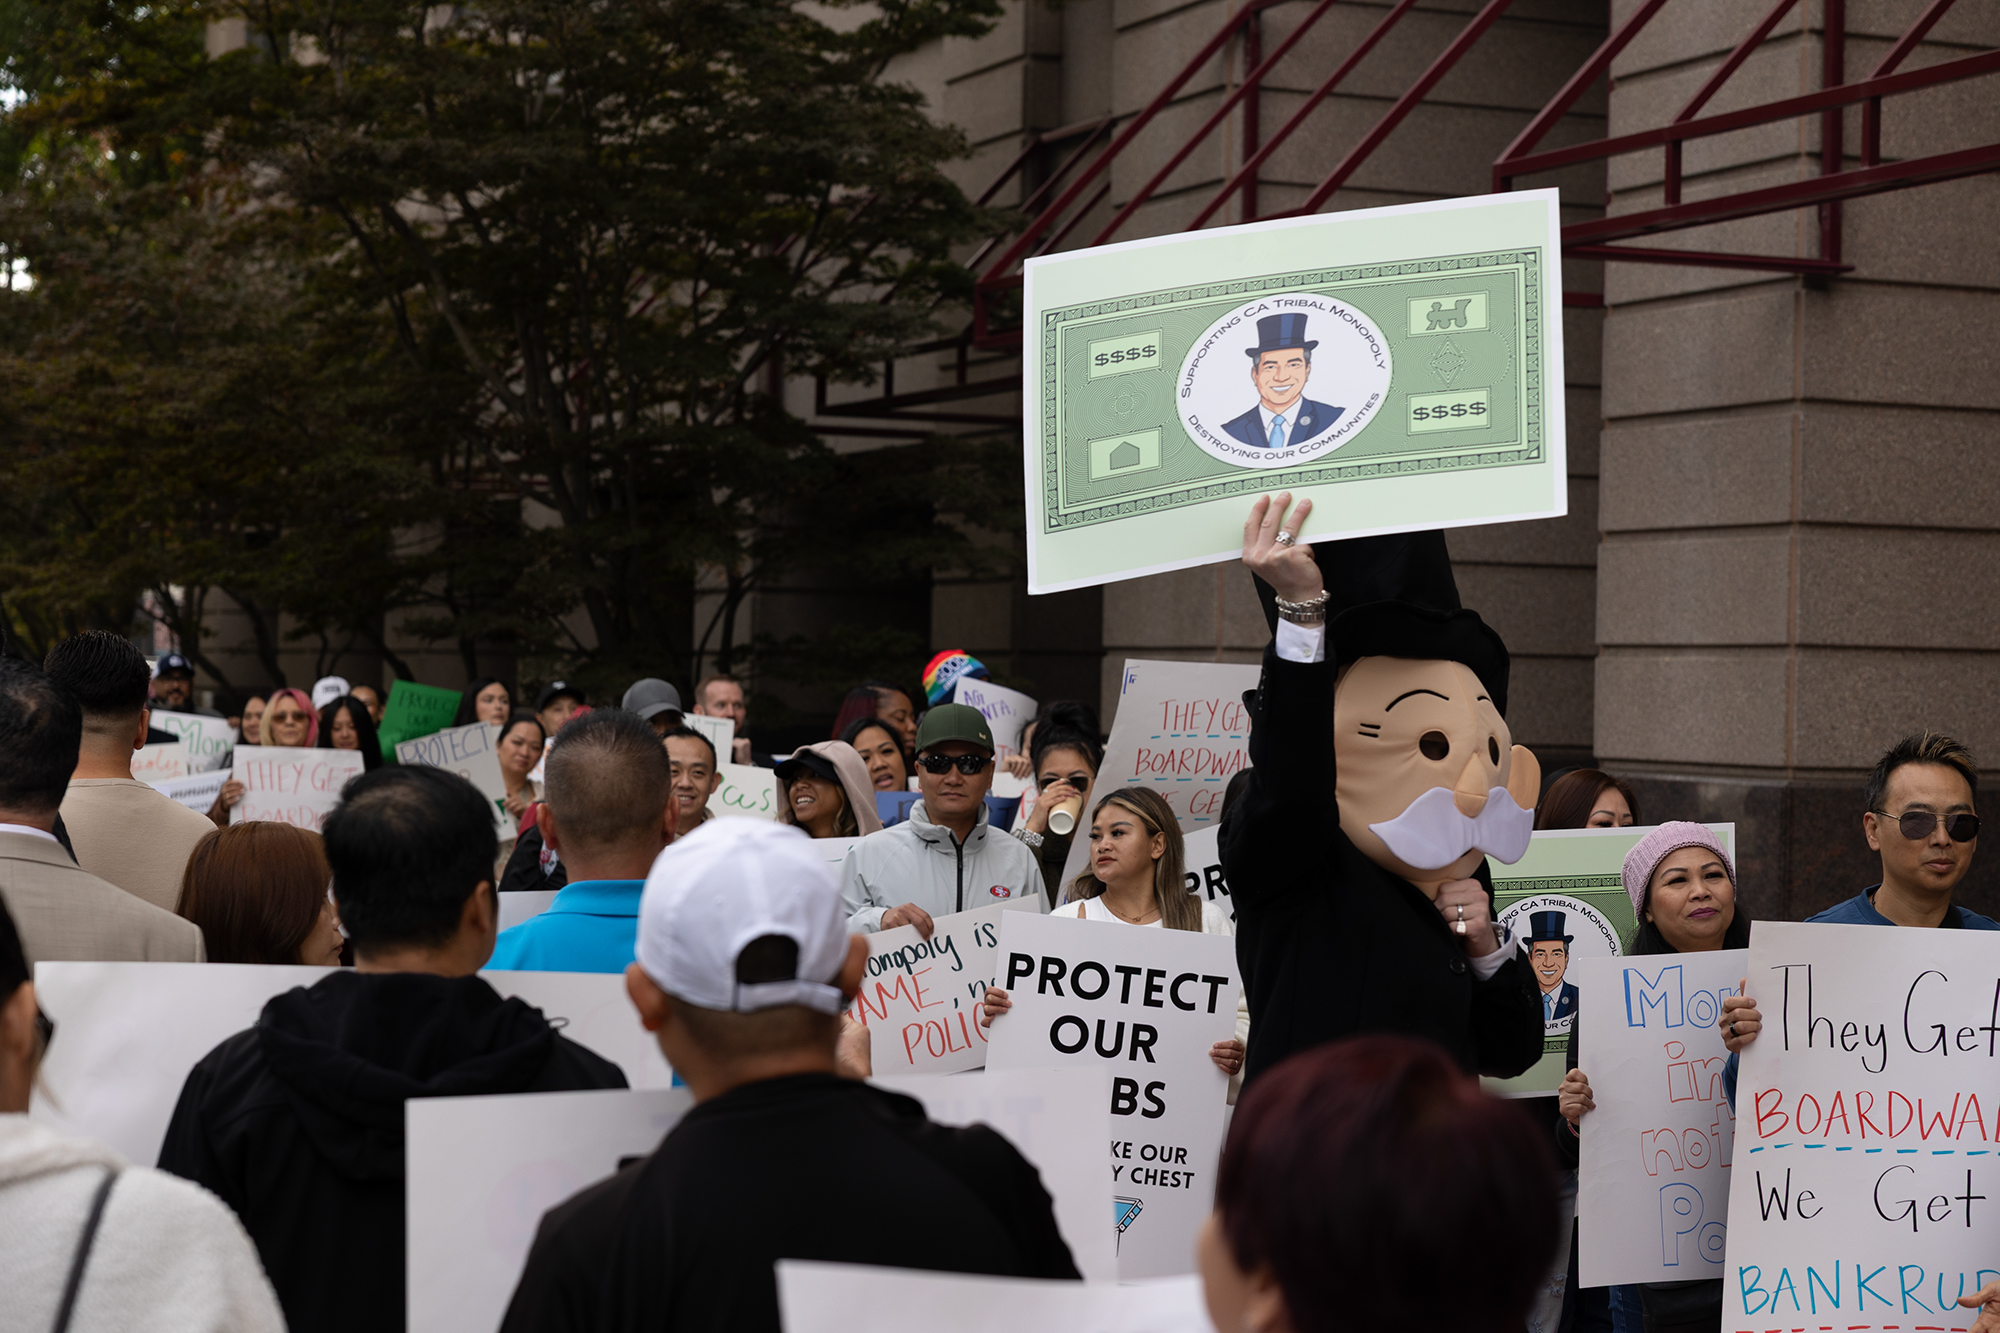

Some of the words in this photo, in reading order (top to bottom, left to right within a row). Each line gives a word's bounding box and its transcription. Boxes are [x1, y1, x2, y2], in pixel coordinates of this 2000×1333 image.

[1181, 316, 1242, 399] SUPPORTING
[1243, 303, 1269, 318] CA
[1272, 298, 1327, 311] TRIBAL
[1329, 305, 1386, 370] MONOPOLY
[1188, 414, 1261, 460] DESTROYING
[1264, 449, 1295, 460] OUR
[1298, 392, 1380, 454] COMMUNITIES
[1159, 698, 1219, 733] THEY
[400, 723, 489, 766] PROTECT
[241, 758, 304, 795] THEY
[974, 922, 998, 948] is
[1520, 900, 1539, 912] CA
[1541, 898, 1578, 912] TRIBAL
[1580, 907, 1619, 957] MONOPOL
[1005, 952, 1229, 1014] PROTECT
[1049, 1014, 1159, 1063] OUR
[1771, 964, 1887, 1073] They
[1110, 1076, 1167, 1119] BS
[1110, 1140, 1133, 1159] KE
[1140, 1144, 1188, 1165] OUR
[1130, 1167, 1195, 1189] CHEST
[1756, 1167, 1824, 1222] We
[1873, 1164, 1987, 1233] Get
